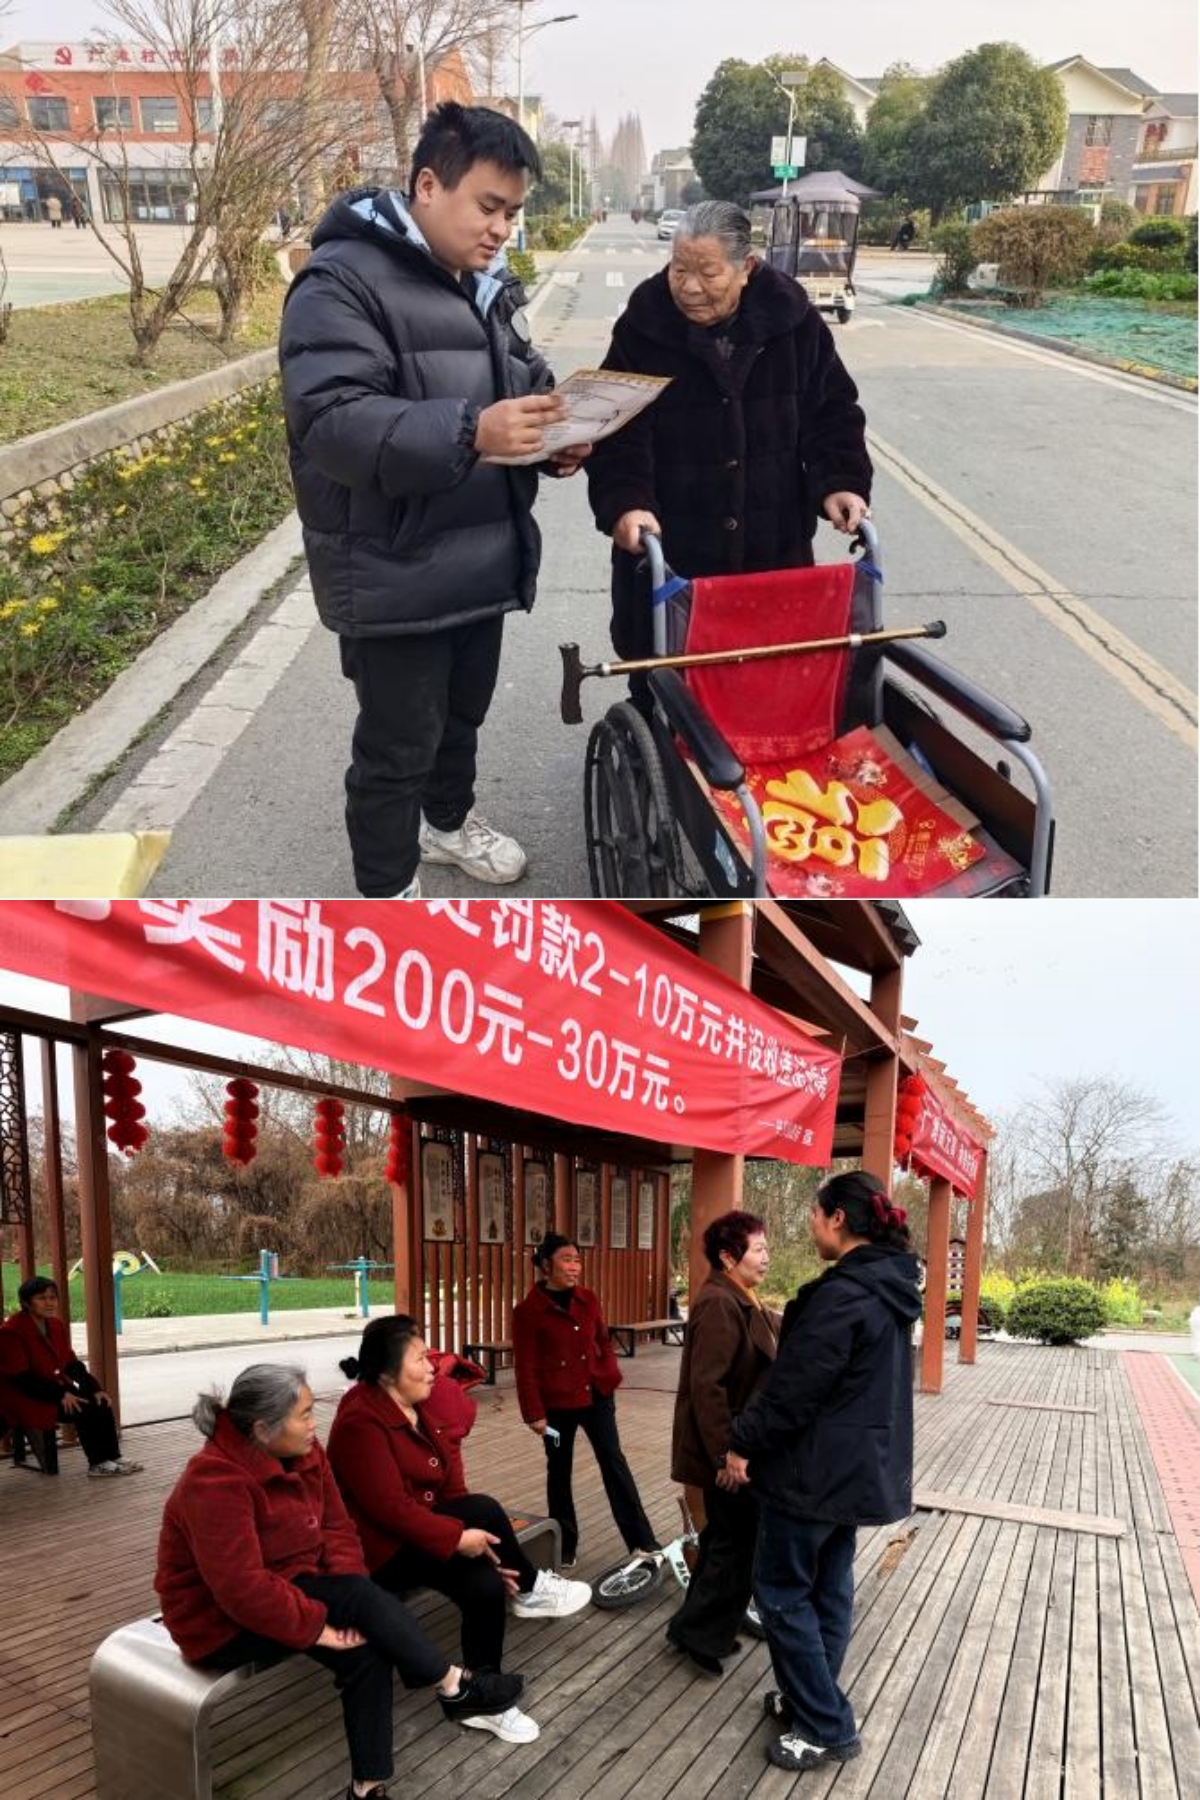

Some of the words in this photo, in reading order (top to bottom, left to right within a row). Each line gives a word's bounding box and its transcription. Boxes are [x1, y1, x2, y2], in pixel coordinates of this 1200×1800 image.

[55, 900, 687, 1114] 奖励200元-30万元。
